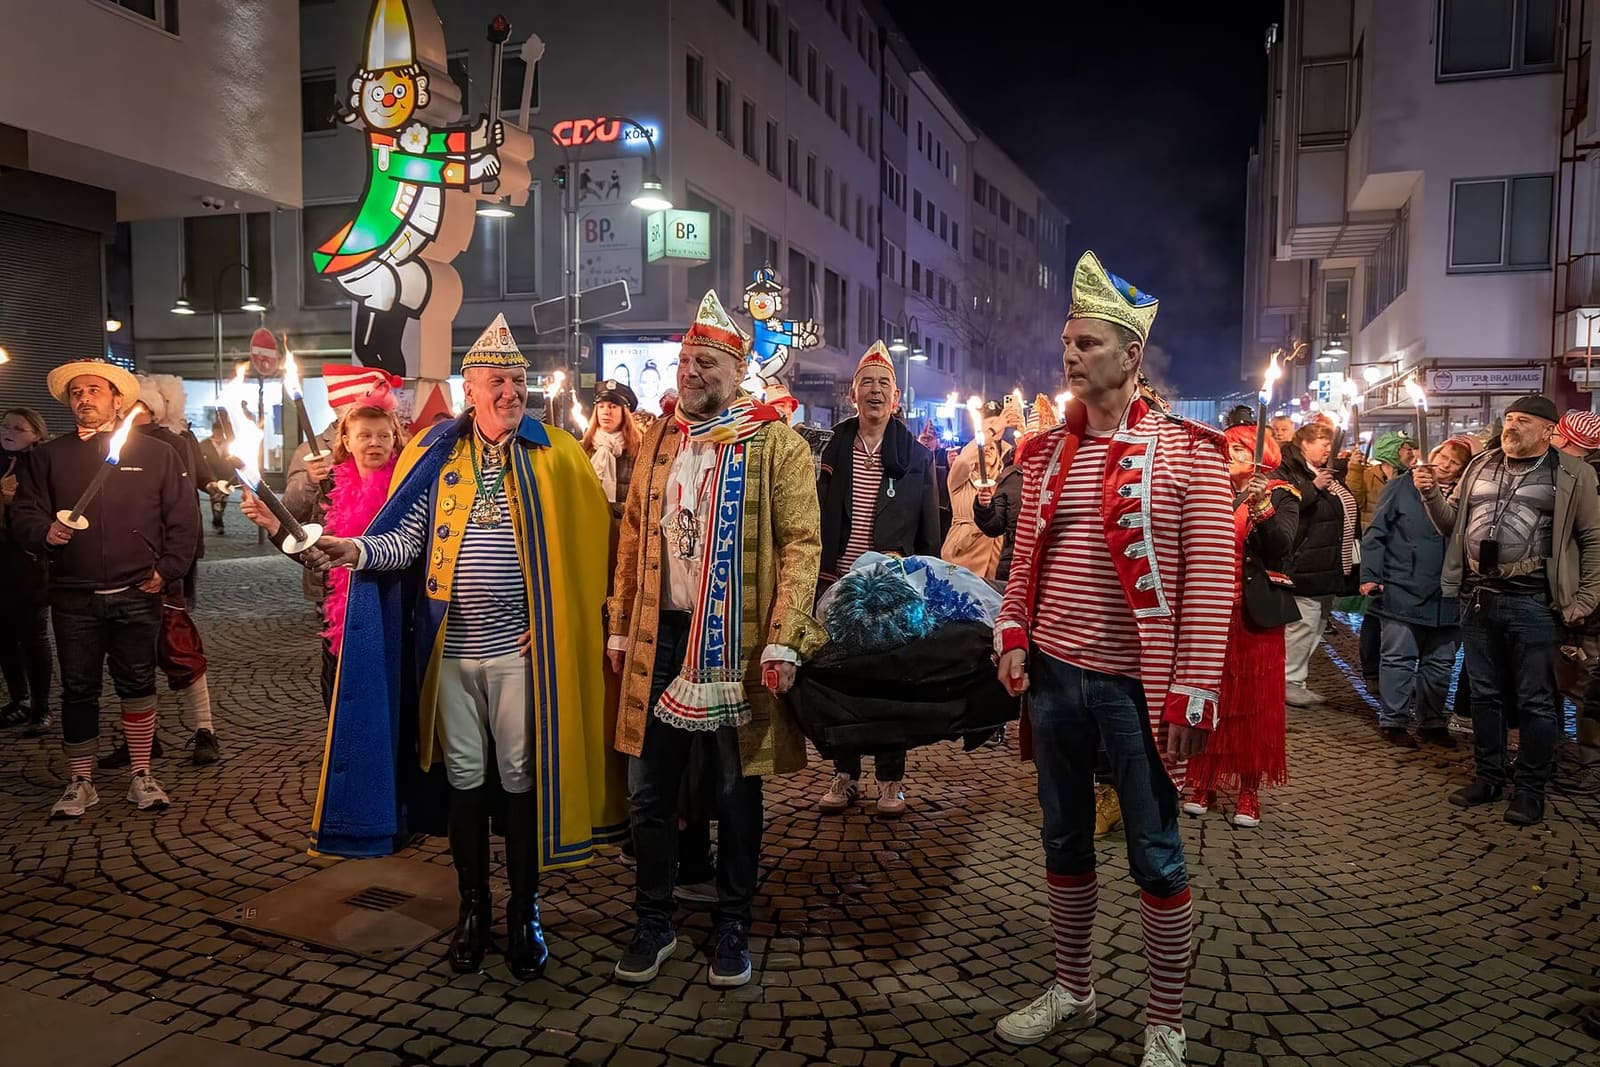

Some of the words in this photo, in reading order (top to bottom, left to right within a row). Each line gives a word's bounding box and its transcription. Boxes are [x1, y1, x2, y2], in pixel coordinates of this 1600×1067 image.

[552, 116, 621, 147] CDU
[625, 127, 654, 140] KÖLN
[1490, 373, 1540, 382] BRAUHAUS
[711, 461, 743, 601] KÖLSCHE
[705, 613, 725, 667] MER
